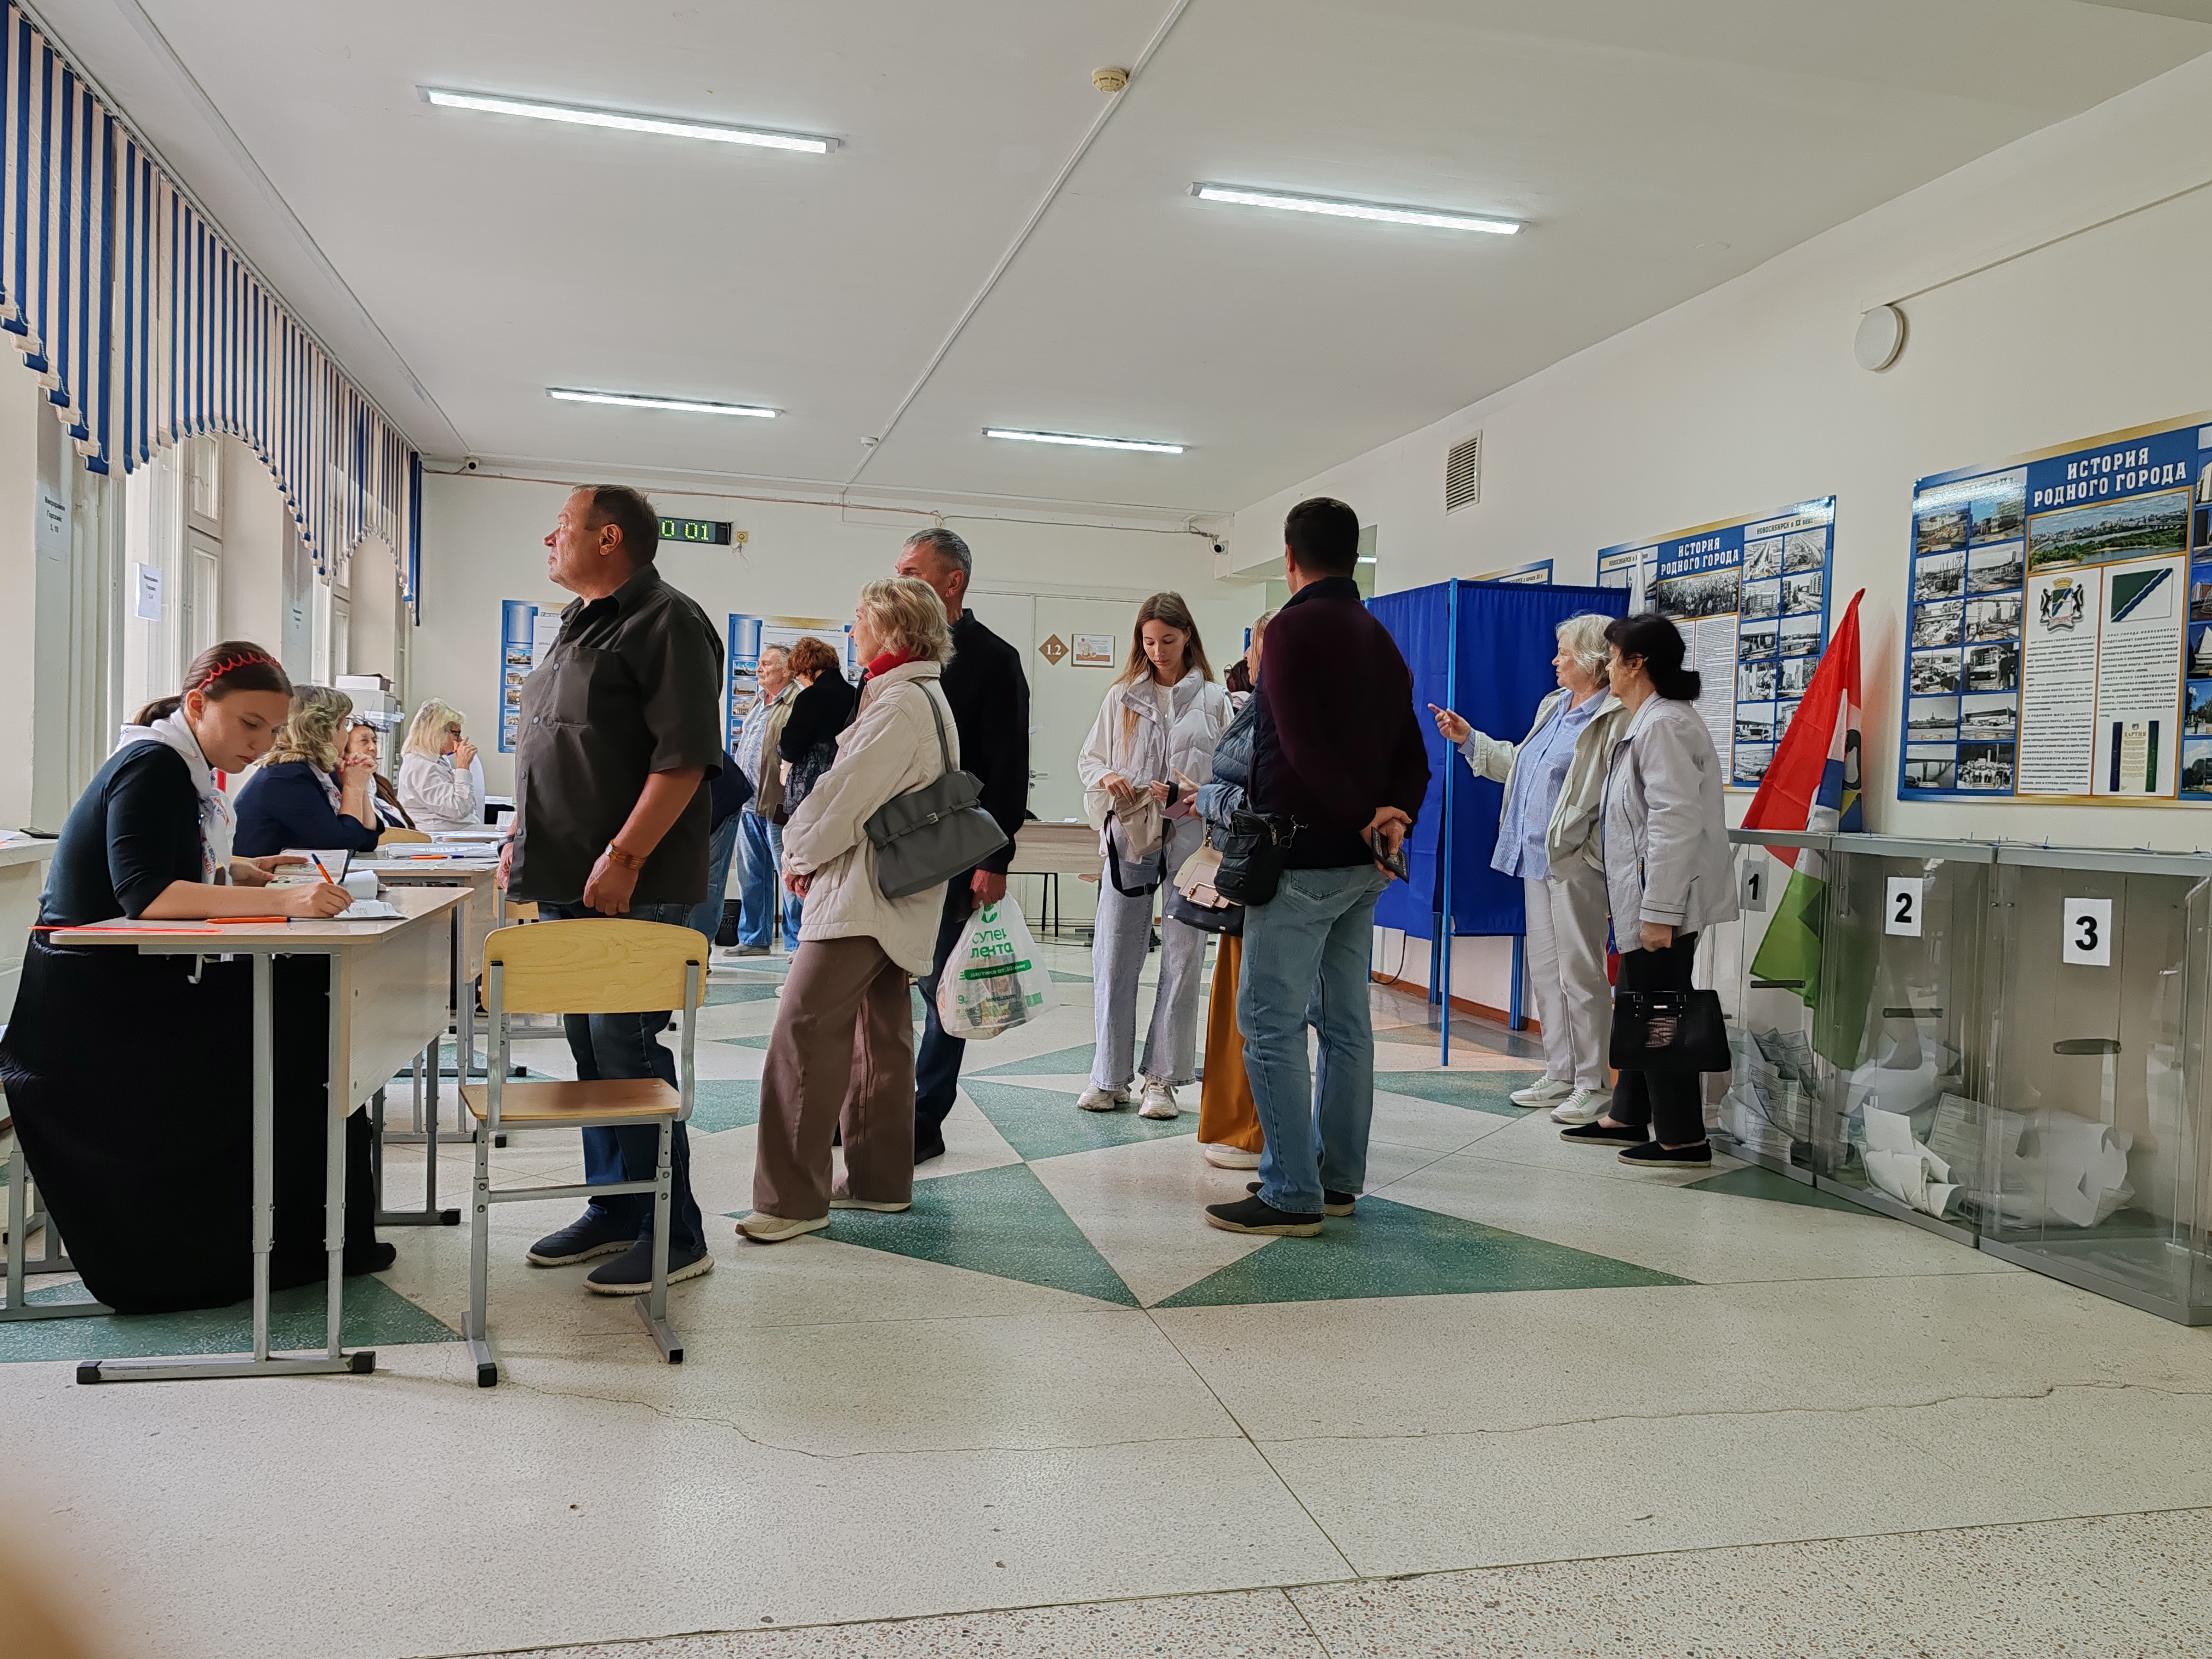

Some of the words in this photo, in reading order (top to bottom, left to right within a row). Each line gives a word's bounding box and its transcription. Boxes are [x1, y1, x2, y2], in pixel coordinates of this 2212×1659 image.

[2067, 447, 2149, 480] ИСТОРИЯ
[2033, 477, 2109, 507] РОДНОГО
[2115, 462, 2186, 491] ГОРОДА
[1756, 521, 1790, 534] НОВОСИБИРСК
[1678, 537, 1720, 557] ИСТОРИЯ
[1661, 557, 1699, 575] РОДНОГО
[1703, 549, 1739, 567] ГОРОДА
[1748, 874, 1759, 900] 1
[1895, 893, 1912, 923] 2
[2075, 916, 2098, 950] 3
[970, 942, 1014, 958] лента
